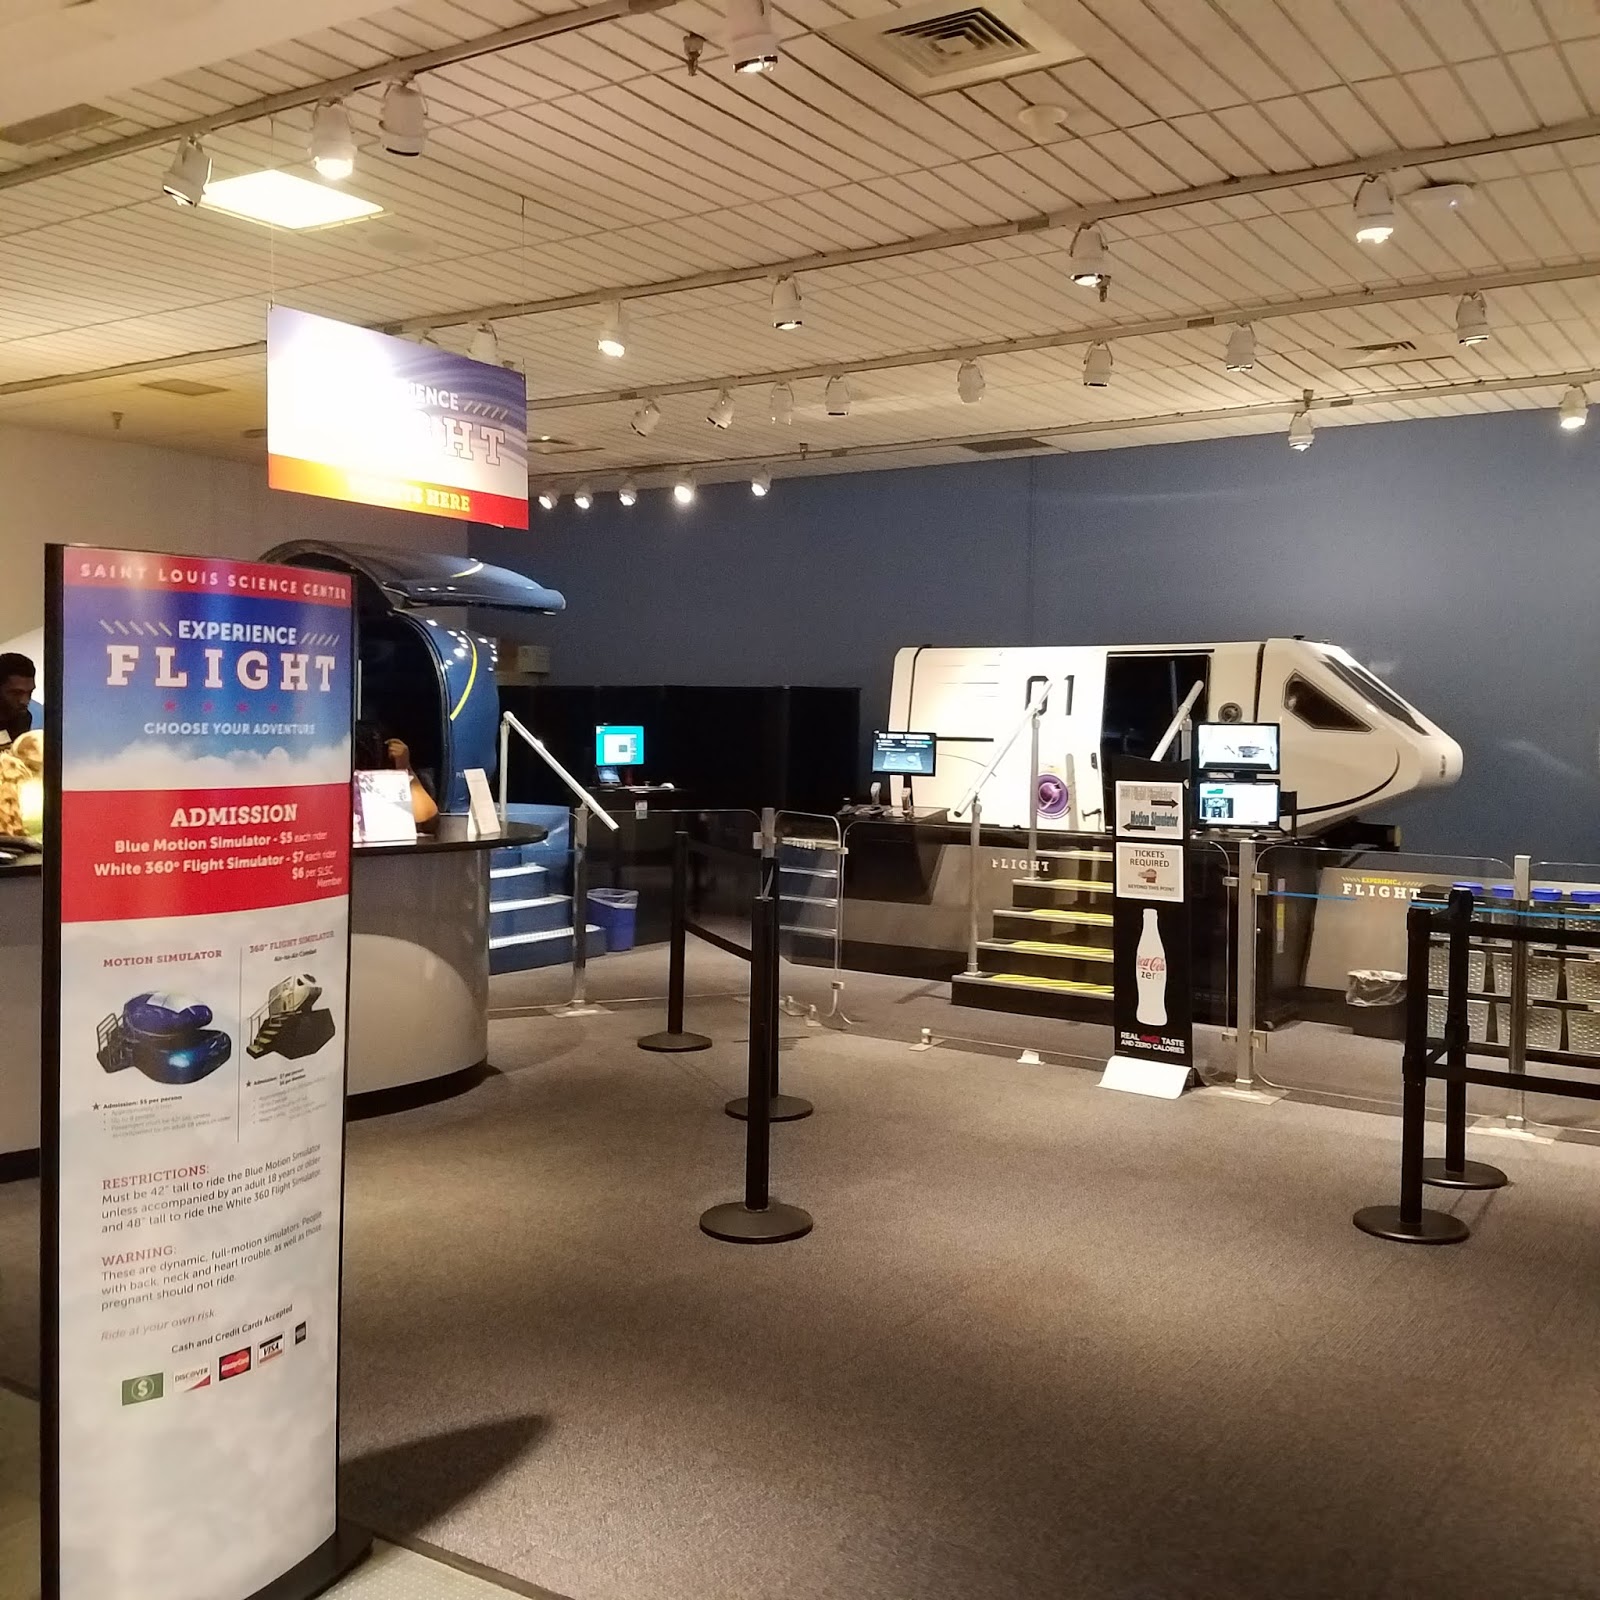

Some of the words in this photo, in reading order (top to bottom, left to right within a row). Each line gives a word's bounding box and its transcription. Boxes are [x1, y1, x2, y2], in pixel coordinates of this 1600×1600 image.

[425, 488, 470, 512] HERE
[79, 563, 147, 581] SAINT
[158, 566, 219, 586] LOUIS
[227, 574, 297, 594] SCIENCE
[303, 582, 347, 600] CENTER
[178, 619, 297, 645] EXPERIENCE
[106, 644, 336, 693] FLIGHT
[144, 722, 209, 735] CHOOSE
[212, 722, 250, 735] YOUR
[252, 723, 316, 736] ADVENTURE
[170, 803, 298, 828] ADMISSION
[114, 839, 150, 854] Blue
[153, 836, 207, 852] Motion
[209, 832, 271, 849] Simulator
[279, 831, 293, 844] $5
[1134, 849, 1165, 858] TICKETS
[93, 860, 142, 877] White
[182, 858, 224, 874] Flight
[226, 854, 284, 870] Simulator
[292, 850, 304, 863] $7
[292, 867, 304, 880] $6
[1129, 858, 1170, 868] REQUIRED
[1342, 882, 1421, 900] FLIGHT
[270, 938, 298, 950] FLIGHT
[103, 956, 153, 967] MOTION
[156, 950, 222, 963] SIMULATOR
[1120, 1031, 1140, 1041] REAL
[1161, 1037, 1185, 1047] TASTE
[1120, 1039, 1134, 1047] AND
[1134, 1041, 1152, 1049] ZERO
[1152, 1044, 1185, 1054] CALORIES
[101, 1192, 130, 1205] Must
[134, 1189, 148, 1200] be
[172, 1182, 189, 1193] tall
[192, 1180, 203, 1190] to
[206, 1176, 225, 1187] ride
[227, 1172, 243, 1182] the
[244, 1167, 263, 1178] Blue
[265, 1156, 291, 1171] Motion
[292, 1144, 321, 1161] Simulator
[102, 1164, 209, 1190] RESTRICTIONS:
[101, 1206, 138, 1219] unless
[141, 1190, 215, 1213] accompanied
[217, 1188, 229, 1199] by
[231, 1185, 243, 1195] an
[244, 1177, 266, 1191] adult
[268, 1172, 277, 1184] 18
[278, 1167, 296, 1182] years
[296, 1163, 304, 1172] or
[101, 1220, 123, 1233] and
[149, 1214, 166, 1225] tall
[169, 1212, 181, 1222] to
[184, 1207, 205, 1219] ride
[207, 1203, 224, 1215] the
[225, 1195, 252, 1210] White
[253, 1188, 270, 1201] 360
[271, 1182, 291, 1196] Flight
[101, 1268, 136, 1281] These
[139, 1264, 157, 1275] are
[211, 1238, 262, 1260] full-motion
[301, 1211, 322, 1226] People
[101, 1245, 177, 1267] WARNING:
[101, 1282, 127, 1295] with
[163, 1271, 190, 1284] neck
[192, 1266, 212, 1279] and
[214, 1259, 238, 1273] heart
[273, 1244, 282, 1253] as
[283, 1235, 297, 1249] well
[297, 1233, 305, 1242] as
[101, 1293, 153, 1312] pregnant
[157, 1283, 194, 1300] should
[196, 1279, 214, 1292] not
[101, 1329, 126, 1341] Ride
[129, 1325, 140, 1336] at
[142, 1320, 169, 1335] your
[171, 1315, 195, 1326] own
[171, 1340, 195, 1353] Cash
[196, 1335, 213, 1347] and
[215, 1327, 240, 1341] Credit
[241, 1320, 263, 1333] Cards
[264, 1304, 293, 1324] Accepted
[263, 1341, 279, 1356] VISA
[174, 1367, 209, 1382] DISCOVER
